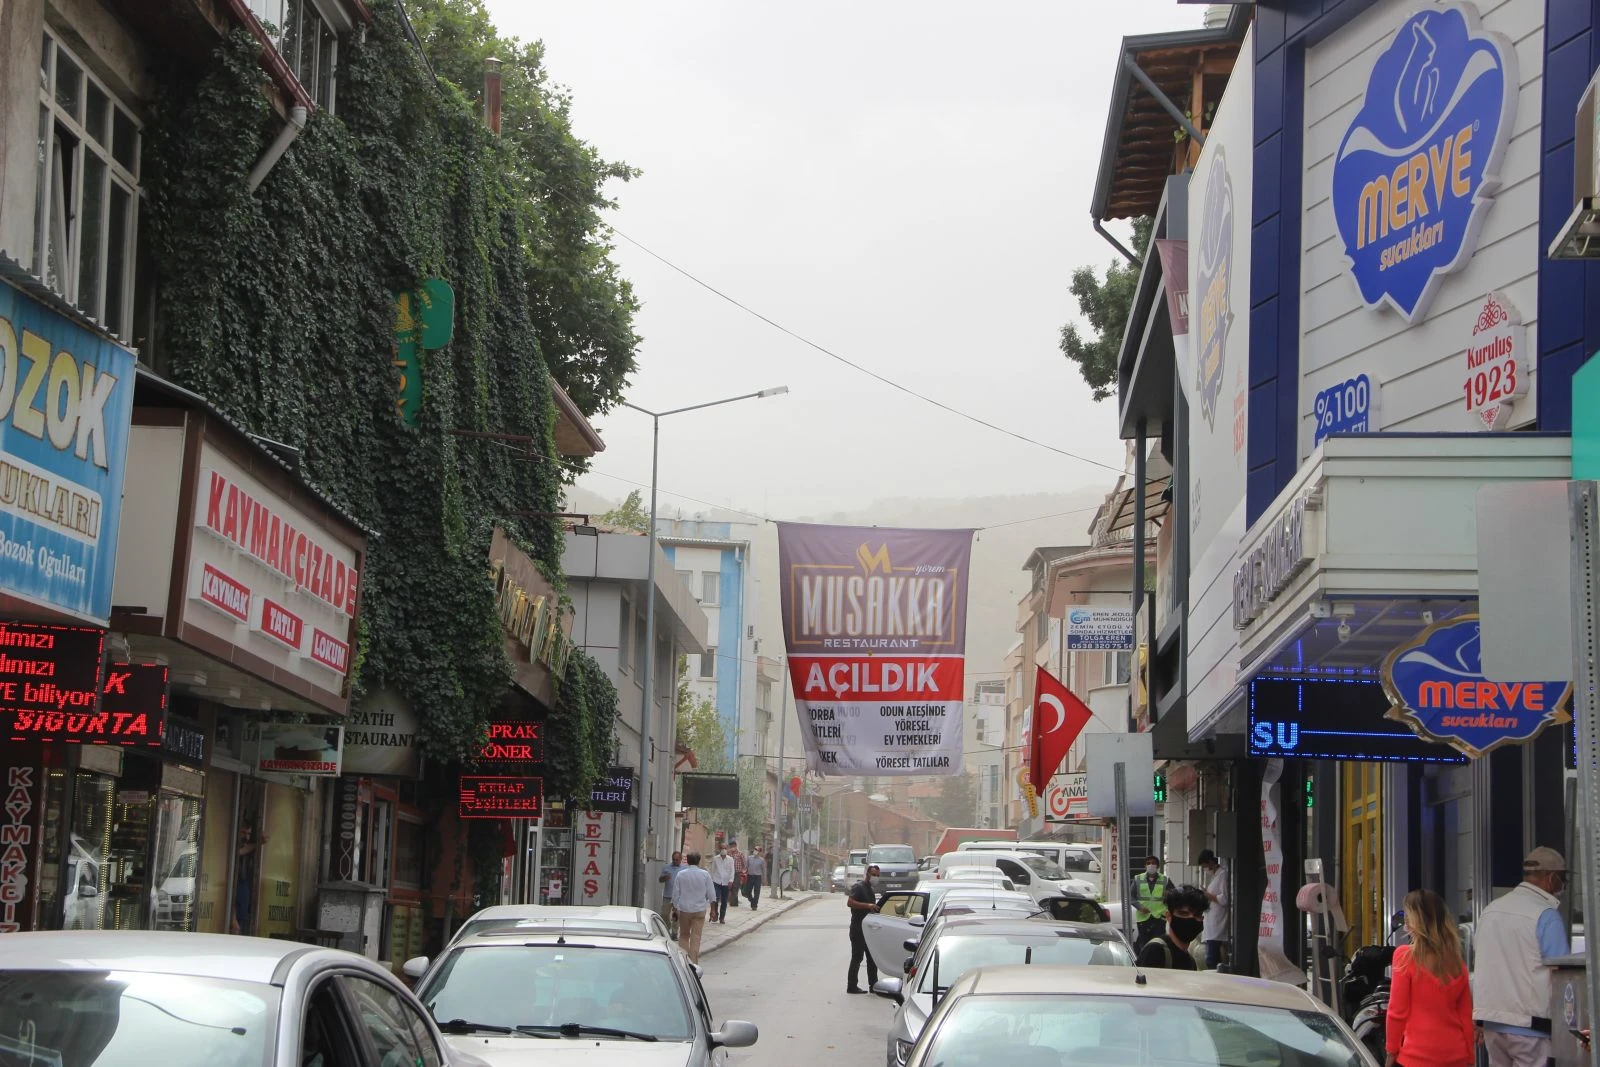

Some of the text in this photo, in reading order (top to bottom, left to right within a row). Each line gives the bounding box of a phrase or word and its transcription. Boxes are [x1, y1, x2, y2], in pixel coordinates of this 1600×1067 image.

[1357, 124, 1472, 249] MERVE
[1380, 221, 1444, 271] sucukları
[1468, 335, 1512, 370] Kuruluş
[1464, 360, 1516, 411] 1923
[1317, 381, 1367, 430] %100
[207, 470, 357, 619] KAYMAKÇIZADE
[38, 546, 87, 585] Oğulları
[915, 563, 945, 576] yörem
[203, 570, 249, 616] KAYMAK
[802, 574, 945, 637] MUSAKKA
[270, 608, 295, 641] TATLI
[314, 633, 345, 669] LOKUM
[823, 638, 918, 649] RESTAURANT
[804, 661, 940, 699] AÇILDIK
[1418, 680, 1545, 711] MERVE
[879, 705, 904, 717] ODUN
[905, 703, 946, 718] ATEŞİNDE
[894, 719, 931, 732] YÖRESEL
[1441, 713, 1519, 728] sucukları
[884, 732, 942, 746] EV YEMEKLERİ
[1254, 721, 1298, 749] SU
[875, 757, 911, 769] YÖRESEL
[912, 756, 950, 769] TATLILAR
